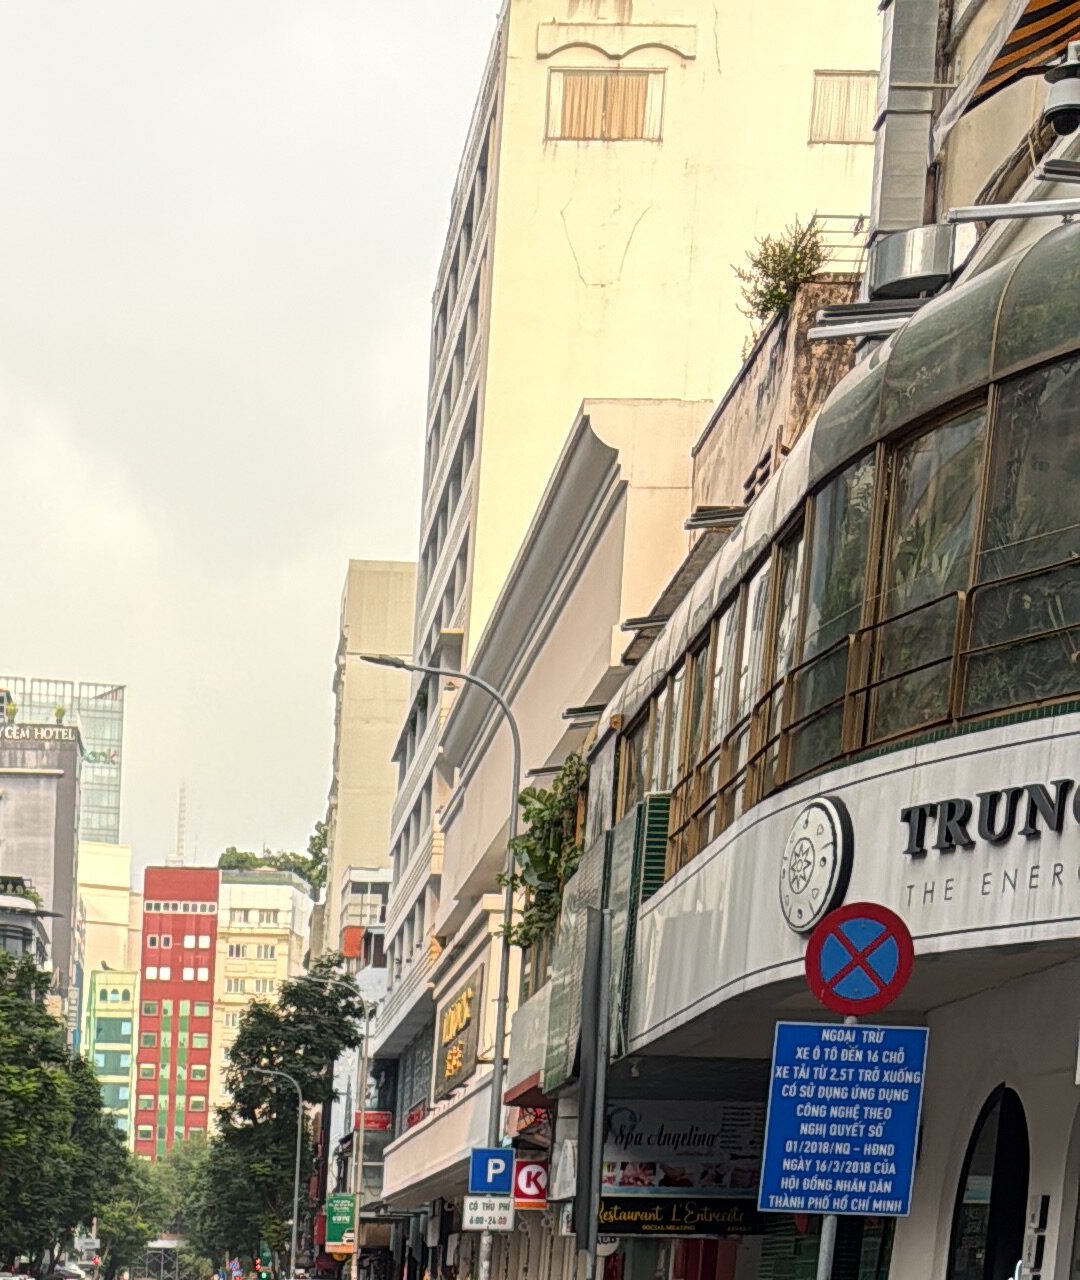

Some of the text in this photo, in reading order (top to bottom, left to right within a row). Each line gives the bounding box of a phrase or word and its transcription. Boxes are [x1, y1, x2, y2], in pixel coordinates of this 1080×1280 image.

[34, 727, 75, 740] HOTEL
[900, 779, 1080, 858] TRUN
[907, 863, 1080, 907] THE ENER
[822, 1028, 885, 1045] NGOẠI TRỪ
[796, 1047, 810, 1060] XE
[813, 1047, 820, 1060] Ô
[824, 1047, 837, 1061] TÔ
[841, 1045, 862, 1062] ĐẾN
[867, 1050, 878, 1062] 16
[775, 1066, 789, 1078] XE
[794, 1064, 809, 1079] TẢI
[814, 1064, 828, 1079] TỪ
[882, 1067, 920, 1084] XUỐNG
[782, 1081, 797, 1097] CÓ
[818, 1086, 848, 1101] DỤNG
[851, 1084, 875, 1100] ỨNG
[878, 1088, 909, 1103] DỤNG
[796, 1102, 892, 1120] CÔNG NGHỆ THEO
[615, 1125, 642, 1150] Spa
[647, 1124, 719, 1150] Angelina
[800, 1122, 886, 1138] NGHỊ QUYẾT SỐ
[864, 1144, 894, 1156] HĐND
[487, 1159, 506, 1183] P
[782, 1156, 896, 1175] NGÀY 16/3/2018 CỦA
[526, 1171, 544, 1194] K
[781, 1175, 799, 1192] HỘI
[803, 1174, 832, 1190] ĐỒNG
[869, 1179, 892, 1193] DÂN
[769, 1193, 902, 1212] THÀNH PHỐ HỒ CHÍ MINH
